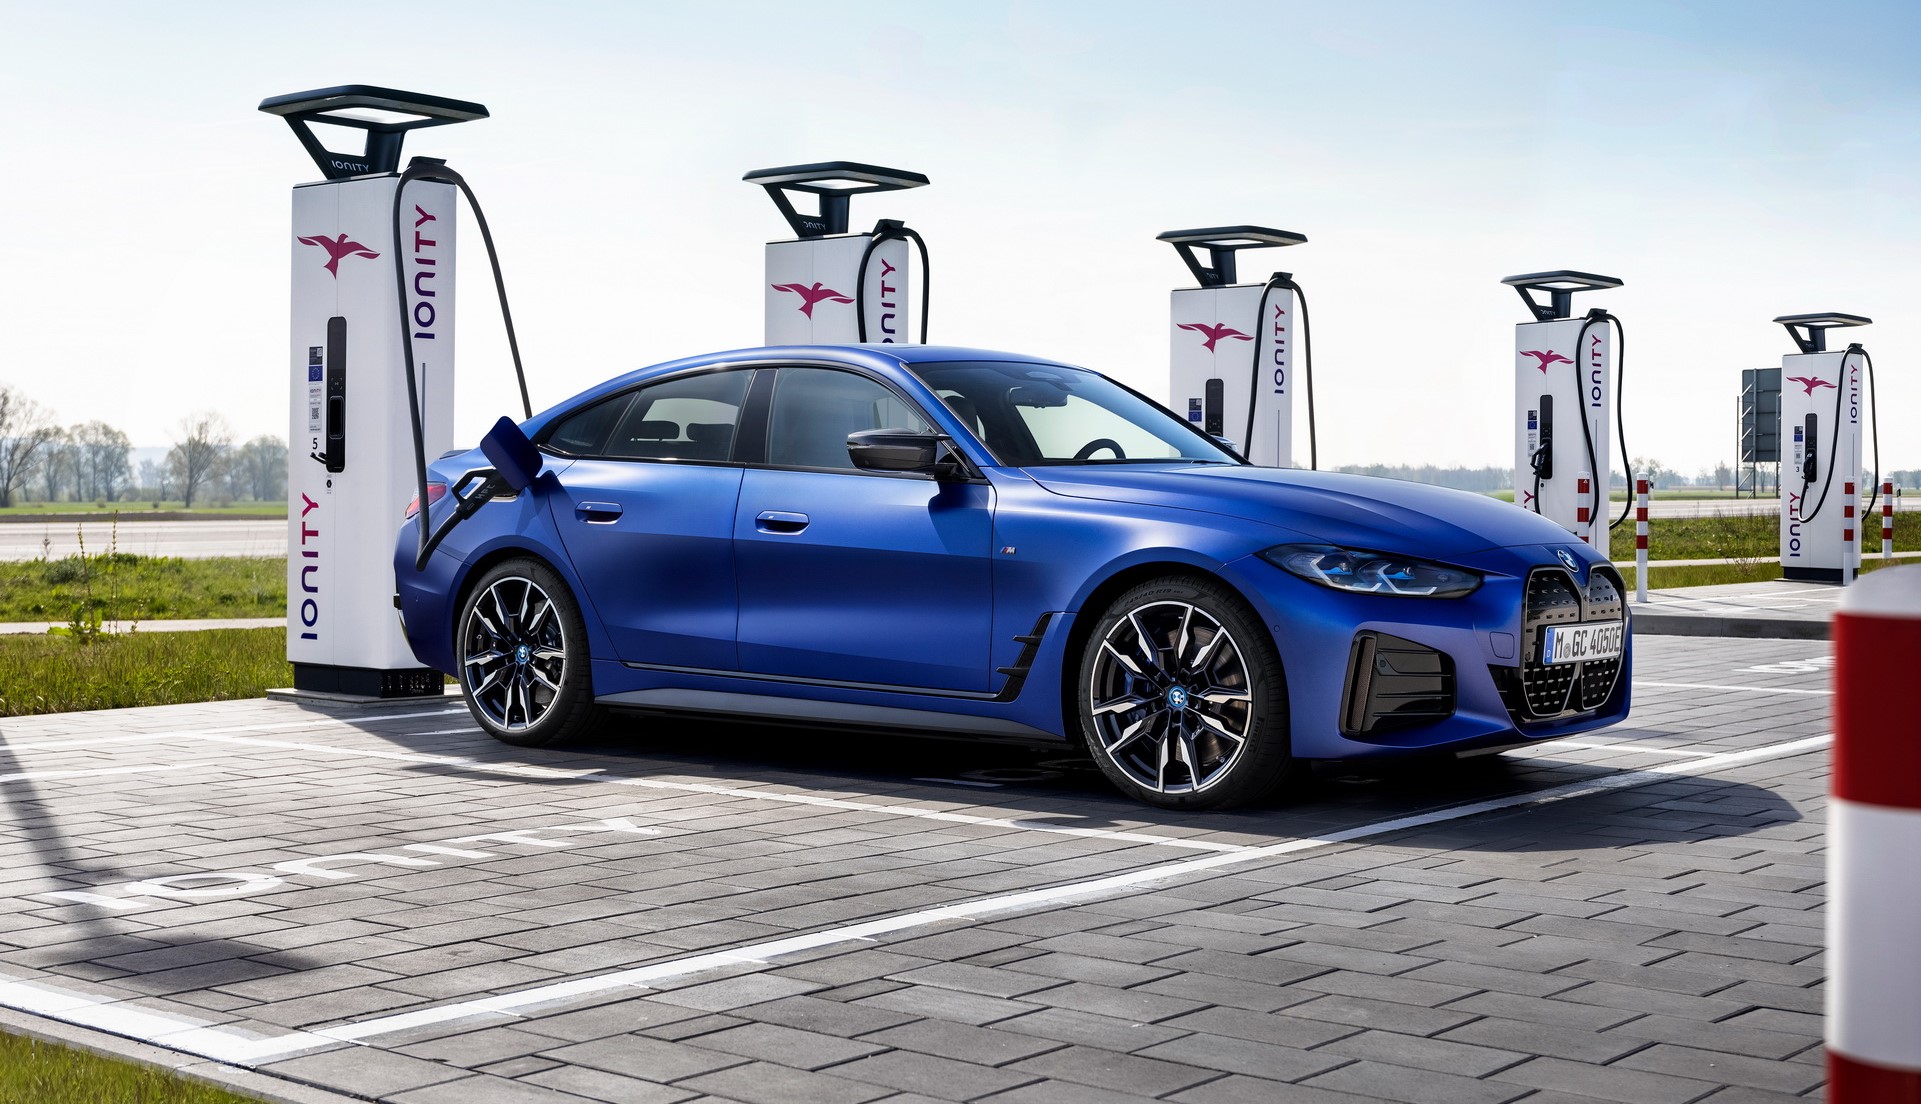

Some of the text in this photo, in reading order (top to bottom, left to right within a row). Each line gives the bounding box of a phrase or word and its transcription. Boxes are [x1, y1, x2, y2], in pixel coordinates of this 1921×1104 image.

[414, 204, 437, 340] IONITY
[1274, 303, 1285, 394] IONITY
[1591, 334, 1602, 408] IONITY
[312, 437, 318, 450] 5
[301, 492, 320, 641] IONITY
[1554, 626, 1621, 659] M GC 4050E
